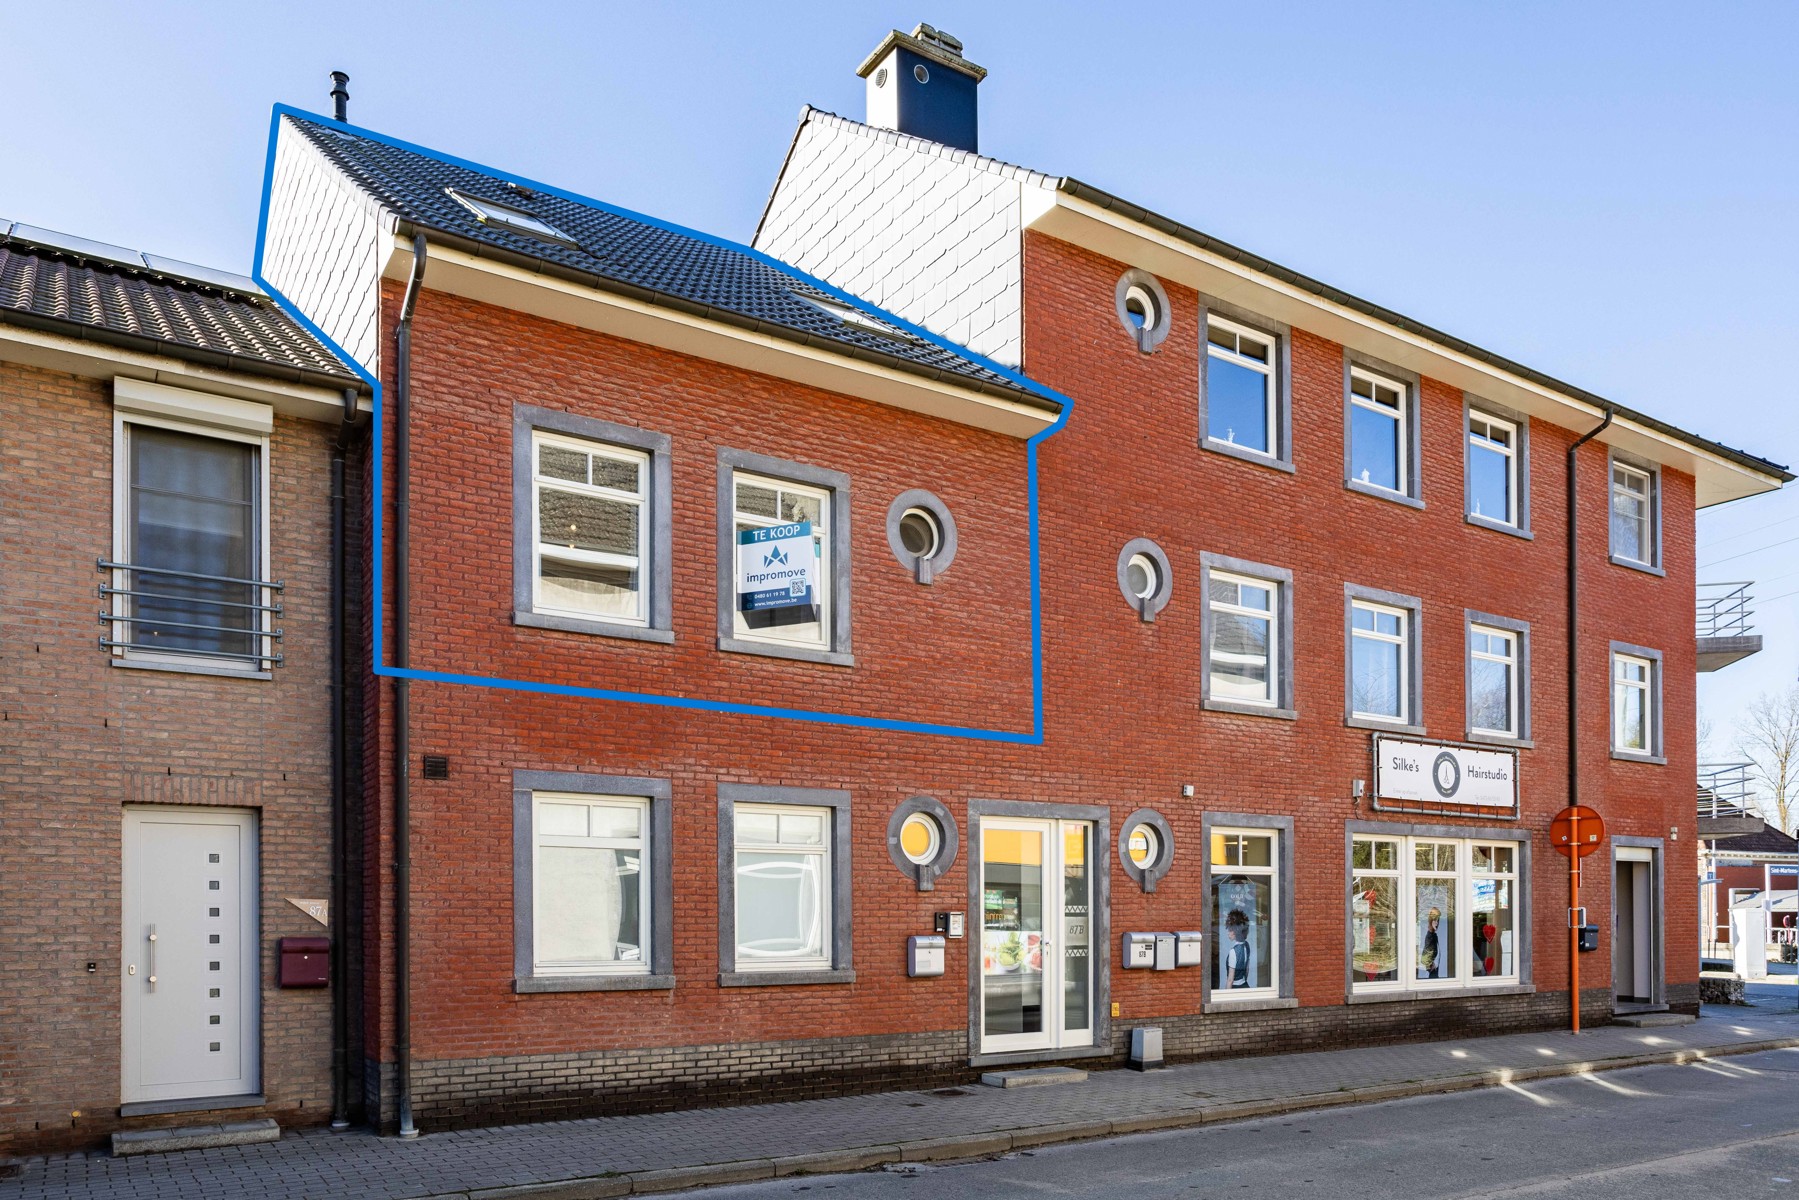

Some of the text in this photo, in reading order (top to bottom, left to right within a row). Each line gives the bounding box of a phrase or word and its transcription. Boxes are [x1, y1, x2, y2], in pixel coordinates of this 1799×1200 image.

[752, 525, 801, 541] TE KOOP
[746, 568, 806, 584] impromove
[1392, 756, 1419, 773] Silke's
[1467, 764, 1508, 781] Hairstudio
[309, 905, 328, 917] 87A
